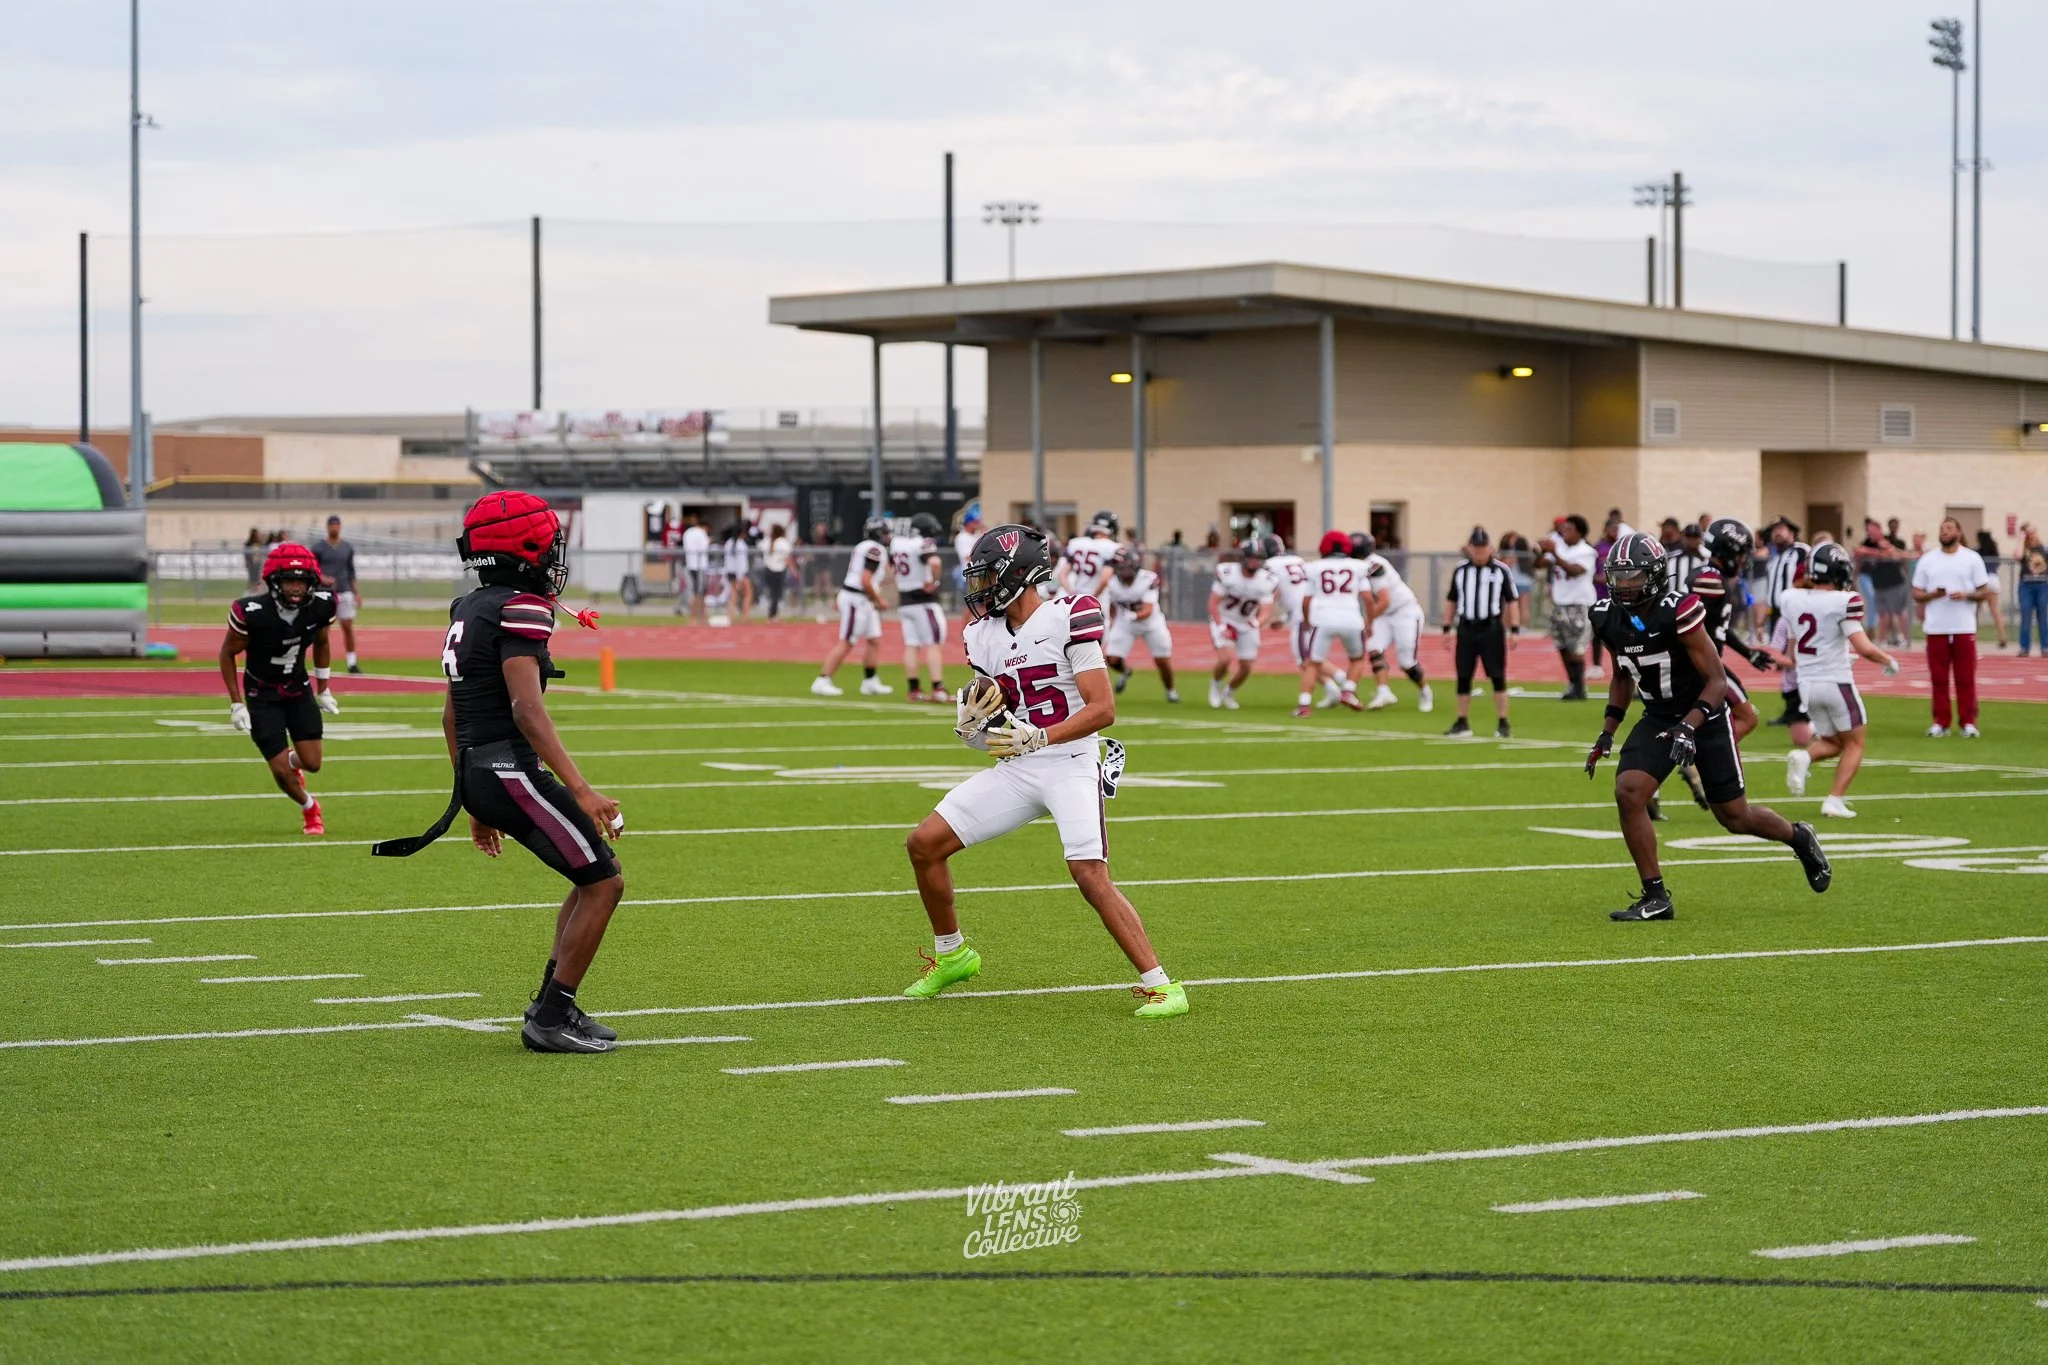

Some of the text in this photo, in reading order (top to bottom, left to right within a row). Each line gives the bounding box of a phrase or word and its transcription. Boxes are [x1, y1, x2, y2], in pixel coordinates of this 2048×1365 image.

[996, 531, 1019, 552] W
[466, 556, 497, 567] ddell
[1073, 550, 1099, 577] 65
[1321, 569, 1353, 594] 62
[244, 601, 262, 612] 4
[1226, 595, 1258, 616] 70
[1797, 612, 1818, 656] 2
[270, 644, 301, 674] 4
[1624, 645, 1644, 653] WEISS
[1004, 654, 1028, 668] WEISS
